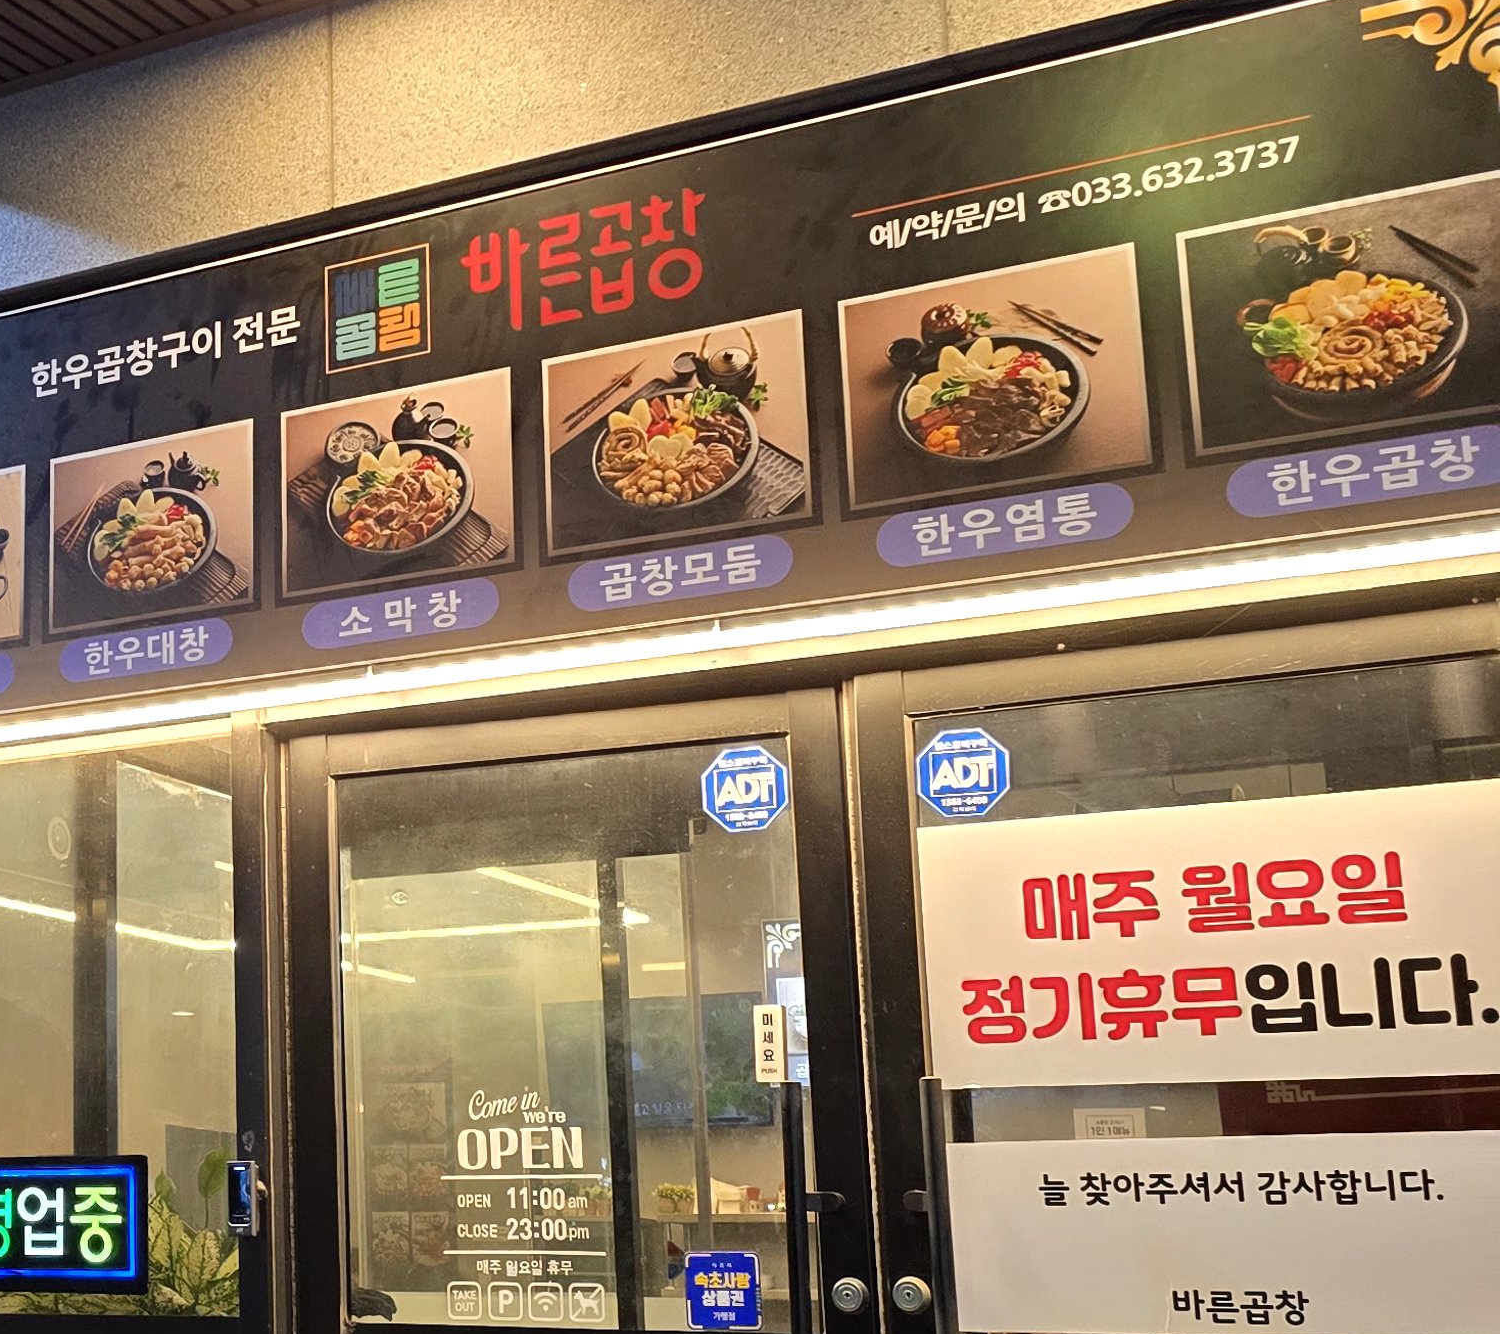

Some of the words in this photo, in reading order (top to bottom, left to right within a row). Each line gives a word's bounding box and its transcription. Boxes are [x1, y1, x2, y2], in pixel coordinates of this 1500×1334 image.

[868, 192, 1026, 250] 예/약/문/의
[461, 187, 706, 330] 바른곱창
[31, 325, 223, 398] 한우곱창구이
[232, 305, 302, 355] 전문
[1267, 434, 1481, 507] 한우곱창
[911, 490, 1098, 558] 한우염통
[598, 543, 762, 603] 곱창모둠
[83, 624, 210, 677] 한우대창
[717, 771, 776, 807] ADT
[931, 755, 996, 791] ADT
[1022, 868, 1161, 942] 매주
[1180, 850, 1408, 935] 월요일
[960, 952, 1500, 1045] 정기휴무입니다.
[762, 1013, 775, 1062] 미세요
[468, 1089, 518, 1121] Come
[520, 1085, 541, 1111] in
[522, 1105, 567, 1124] we're
[456, 1125, 584, 1170] OPEN
[457, 1193, 492, 1208] OPEN
[1038, 1174, 1070, 1207] 늘
[1079, 1170, 1246, 1207] 찾아주셔서
[1257, 1166, 1445, 1207] 감사합니다.
[457, 1224, 498, 1238] CLOSE
[476, 1259, 502, 1276] 매주
[547, 1259, 574, 1276] 휴무
[452, 1289, 477, 1300] TAKE
[454, 1302, 476, 1312] OUT
[1171, 1289, 1310, 1327] 바른곱창
